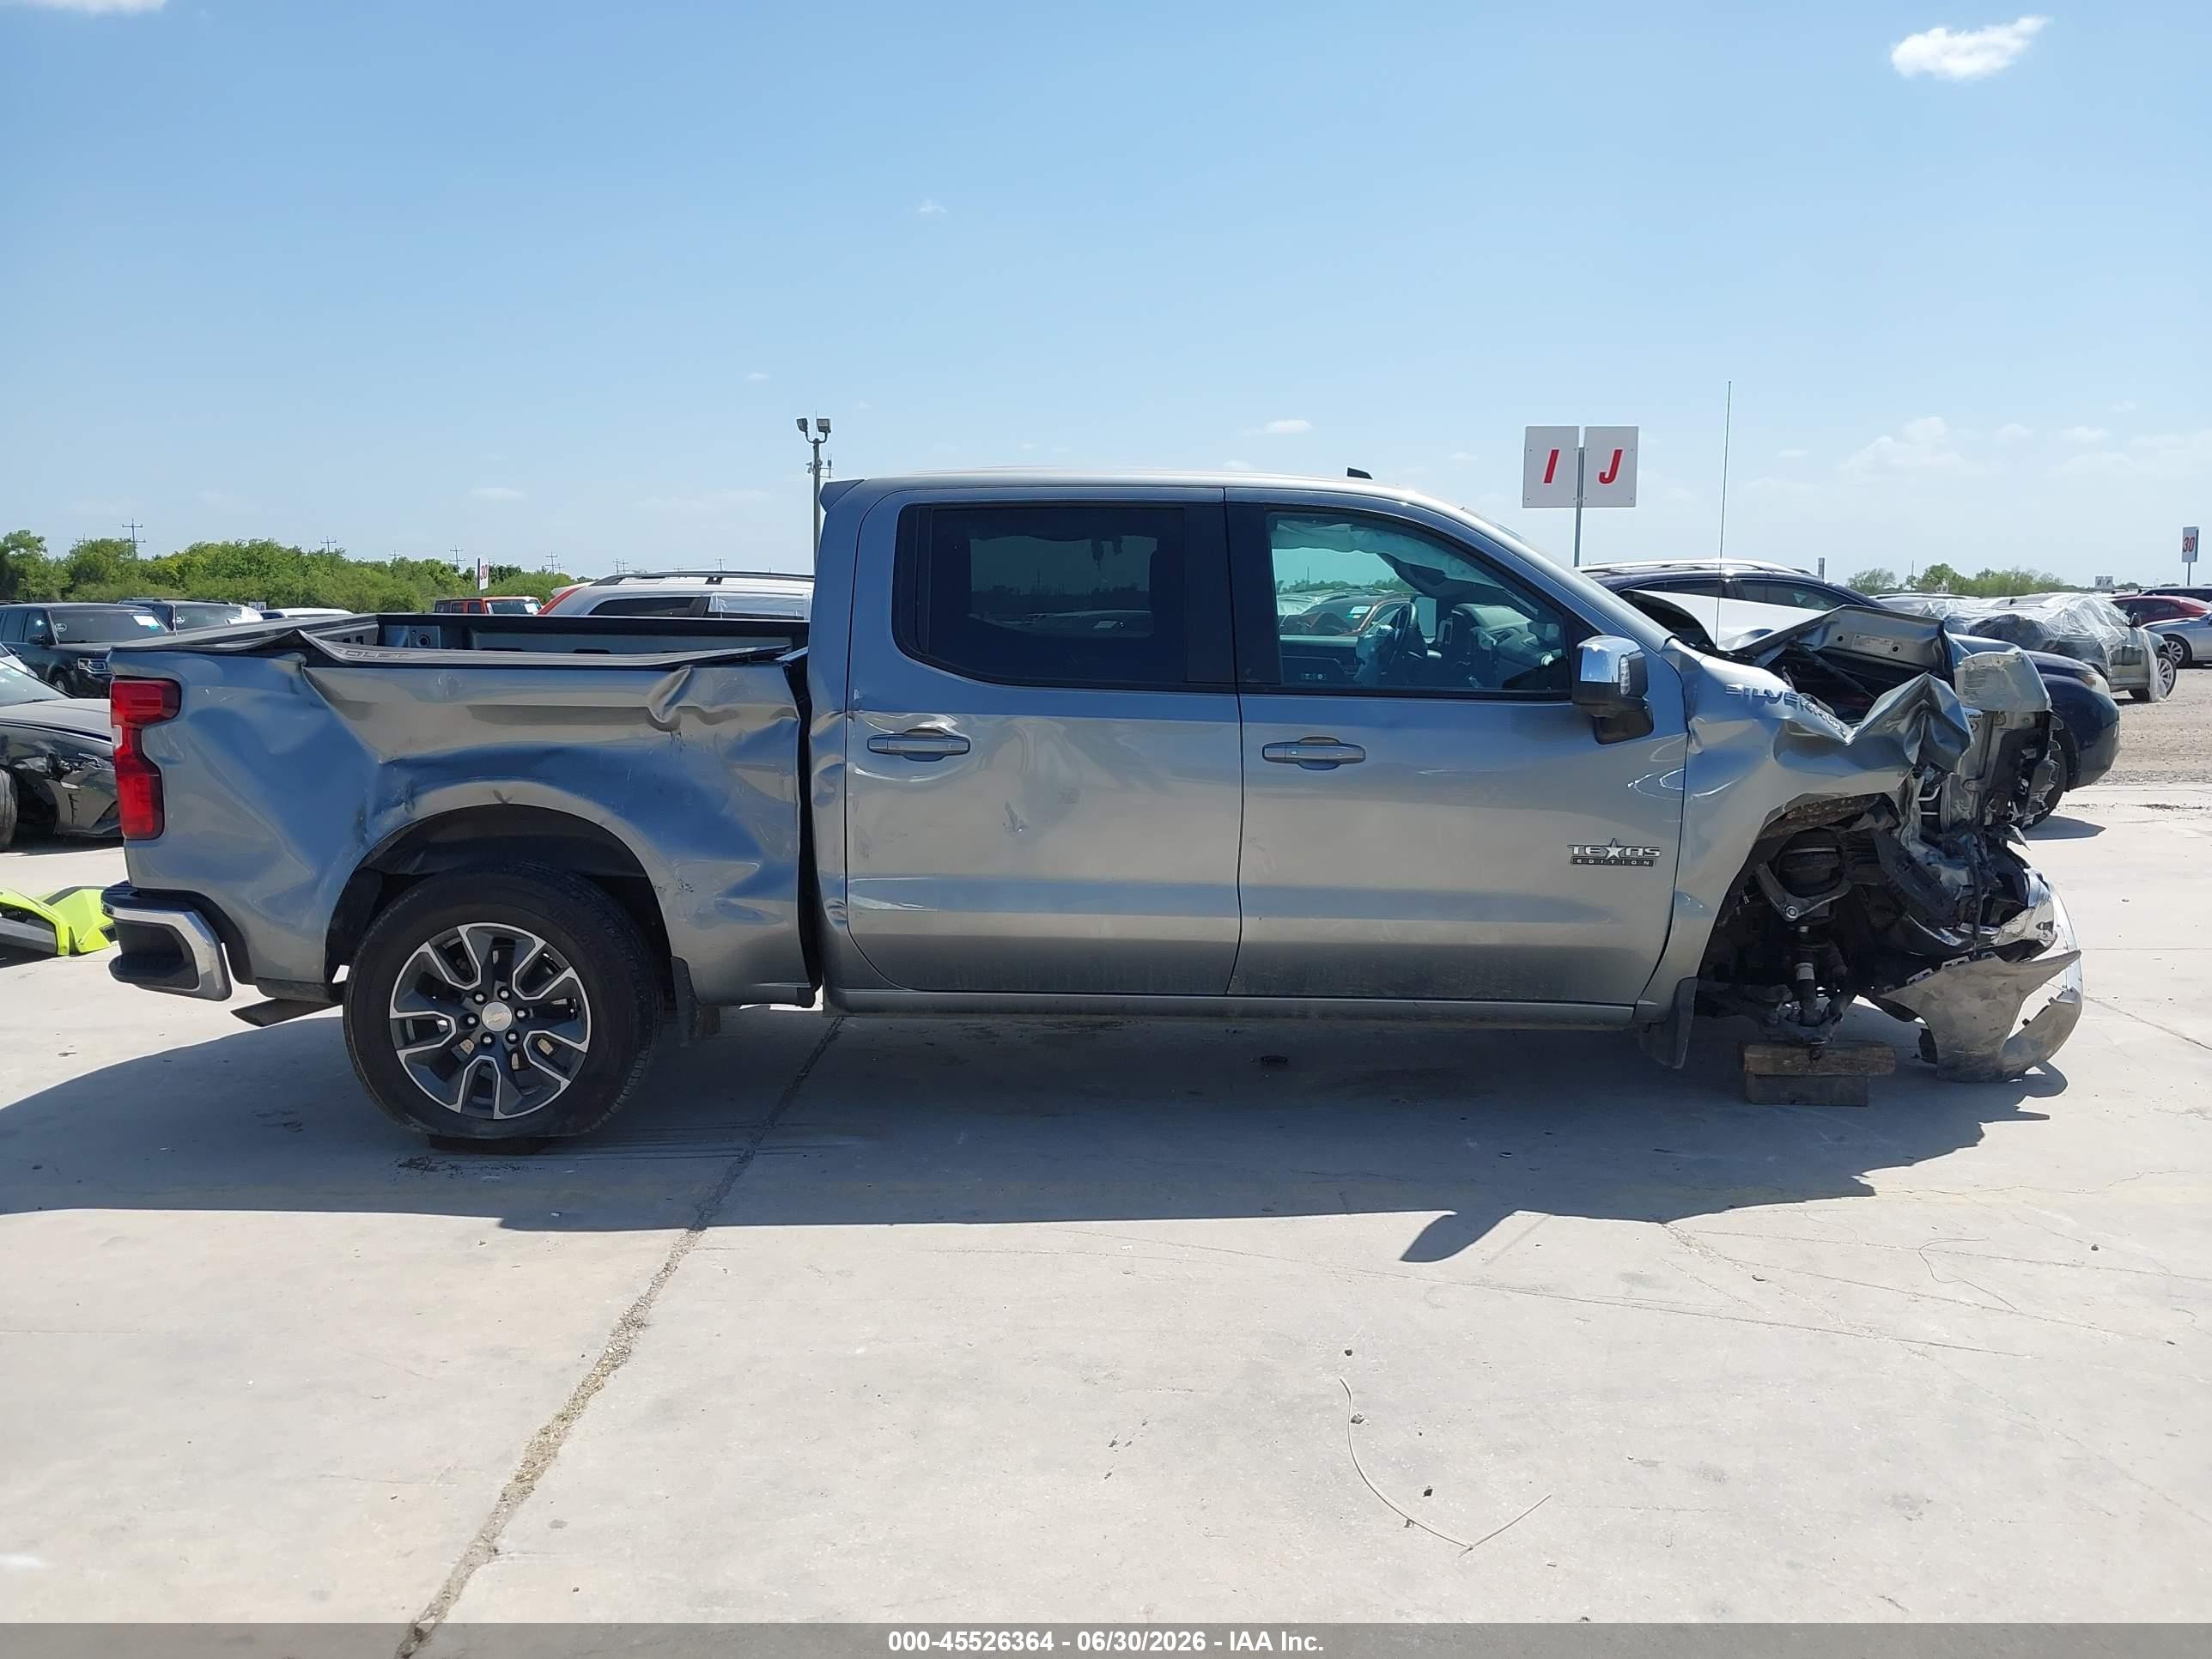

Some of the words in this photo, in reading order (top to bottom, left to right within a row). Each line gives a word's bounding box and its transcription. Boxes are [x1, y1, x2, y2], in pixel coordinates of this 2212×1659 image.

[1598, 449, 1623, 484] J
[2182, 536, 2195, 552] 30
[480, 564, 489, 580] 30
